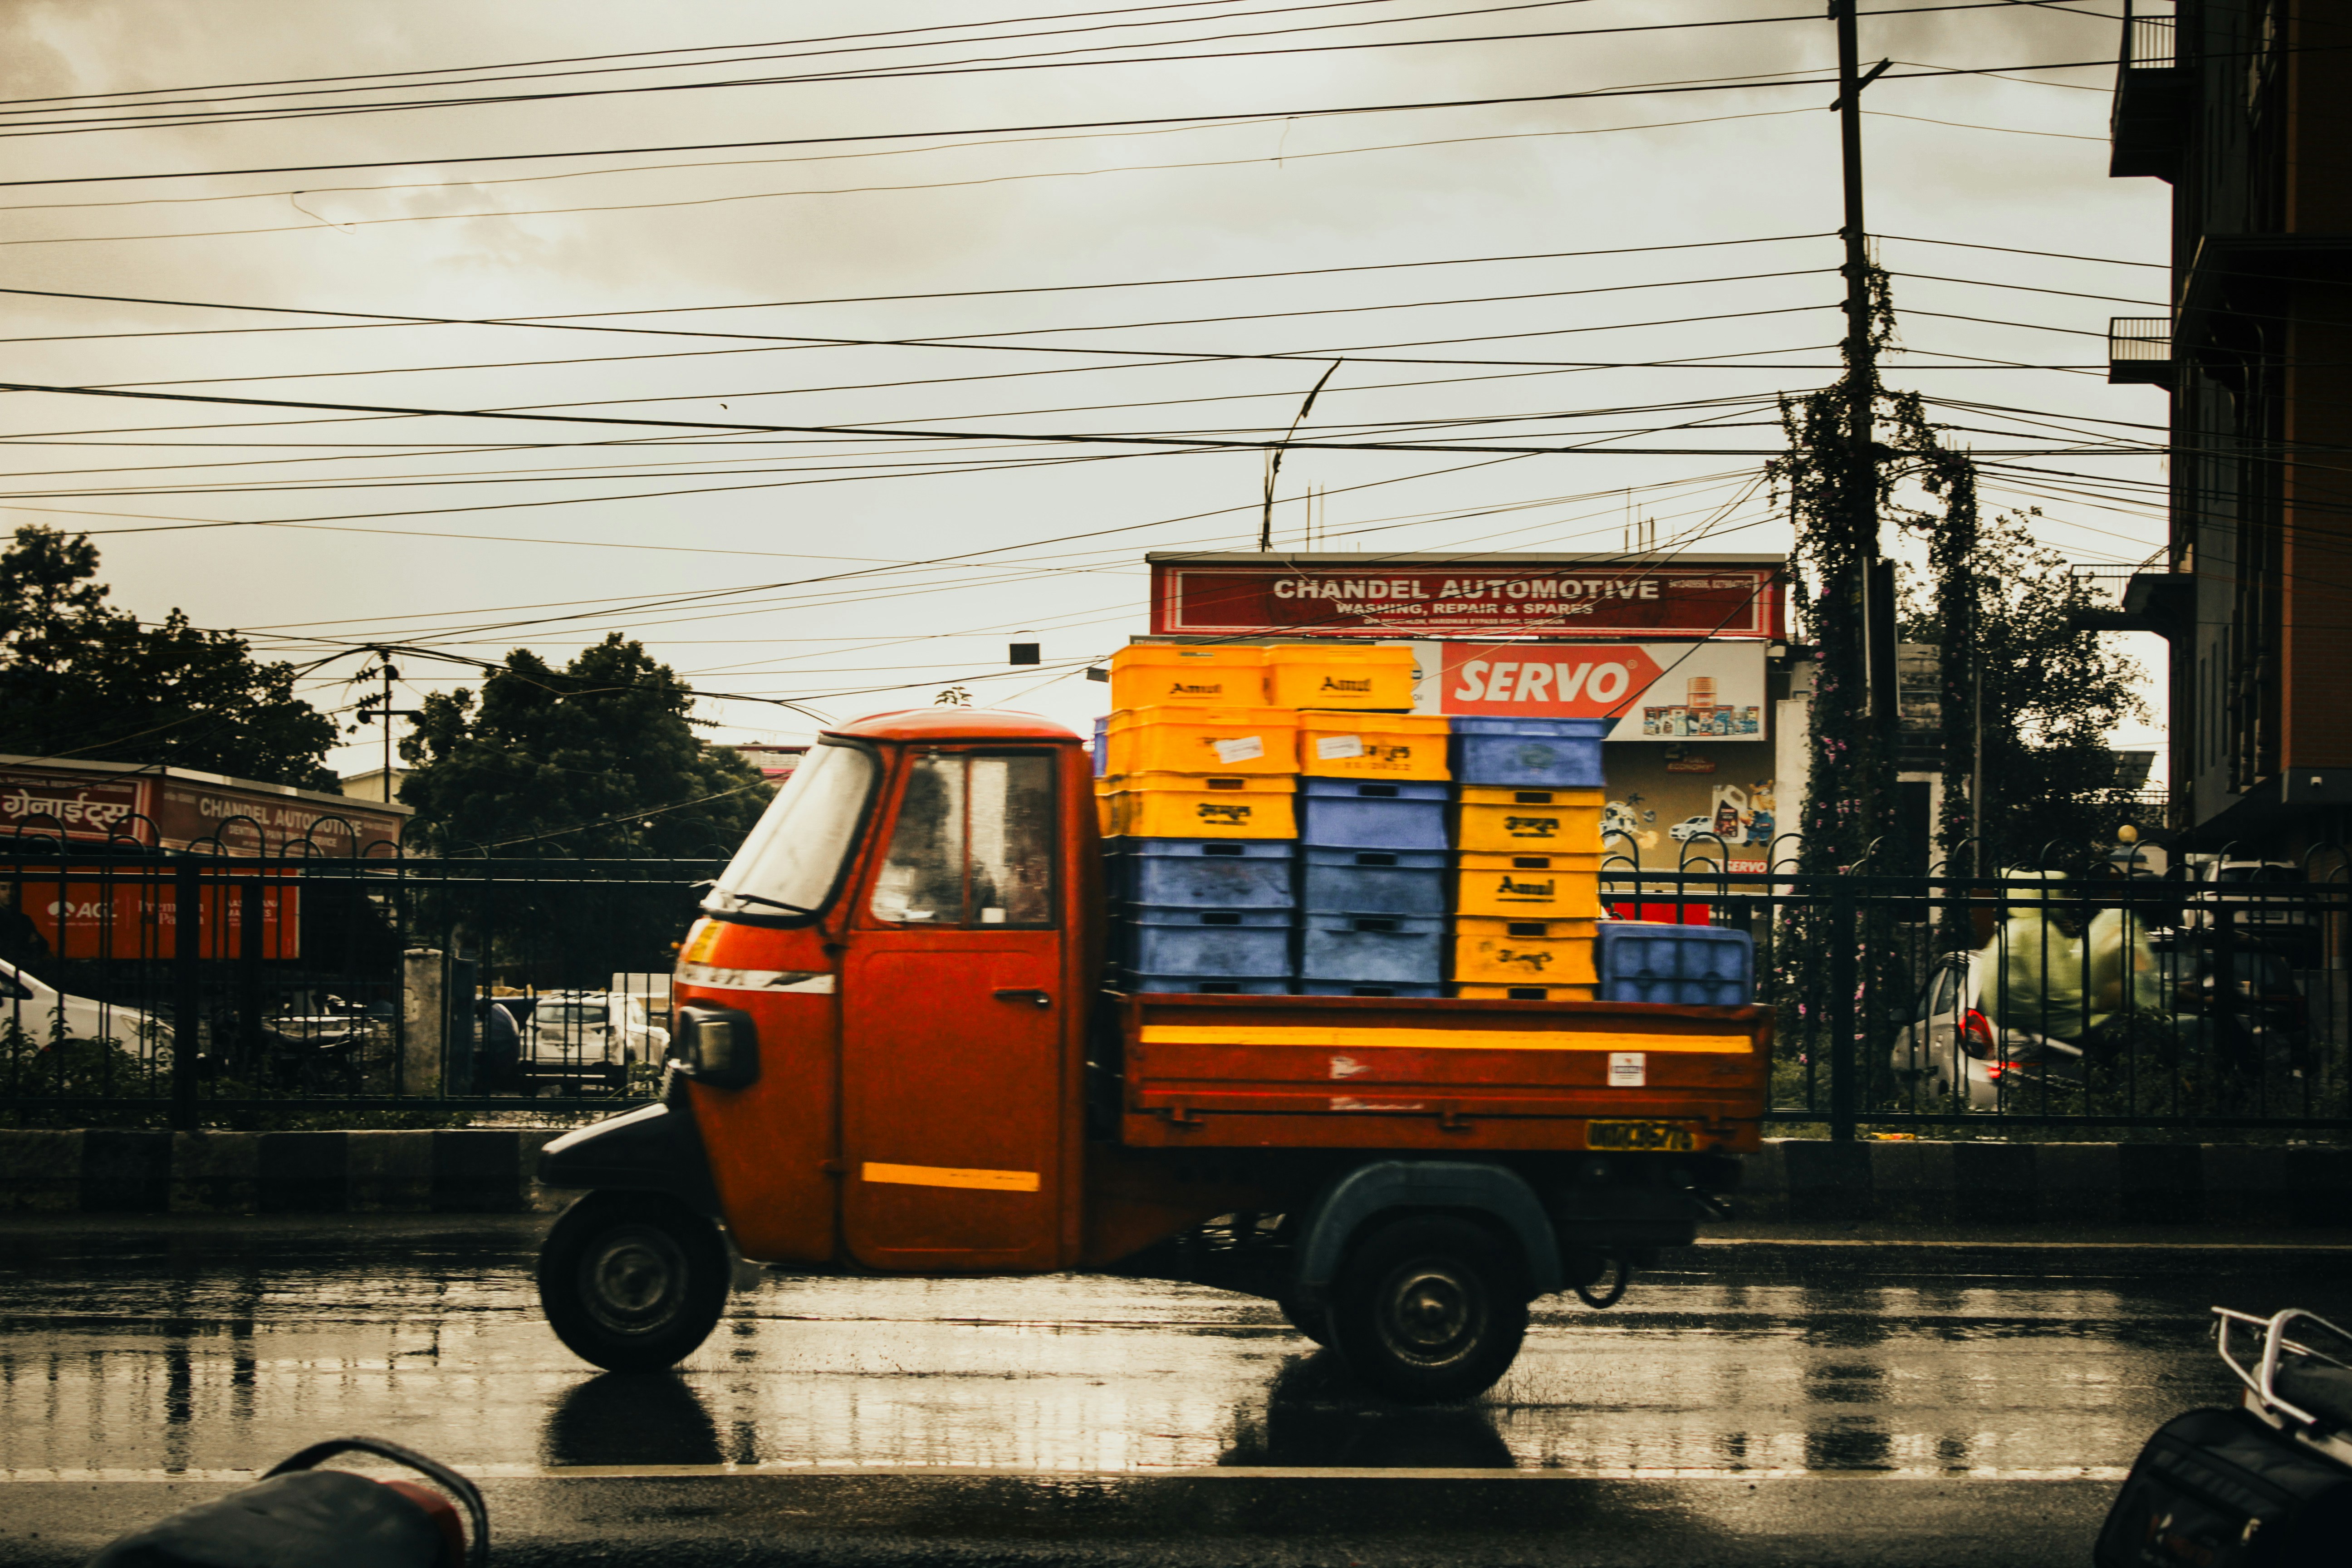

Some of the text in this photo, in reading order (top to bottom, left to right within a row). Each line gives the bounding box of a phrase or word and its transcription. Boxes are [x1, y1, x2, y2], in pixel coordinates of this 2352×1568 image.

[1273, 579, 1430, 599] CHANDEL
[1439, 579, 1659, 599] AUTOMOTIVE
[1336, 603, 1594, 617] WASHING, REPAIR & SPARES
[1319, 676, 1372, 691] Amul
[1454, 660, 1629, 703] SERVO
[200, 797, 271, 824] CHANDEL
[1727, 861, 1768, 872] SERVO
[1497, 876, 1555, 896] Amul
